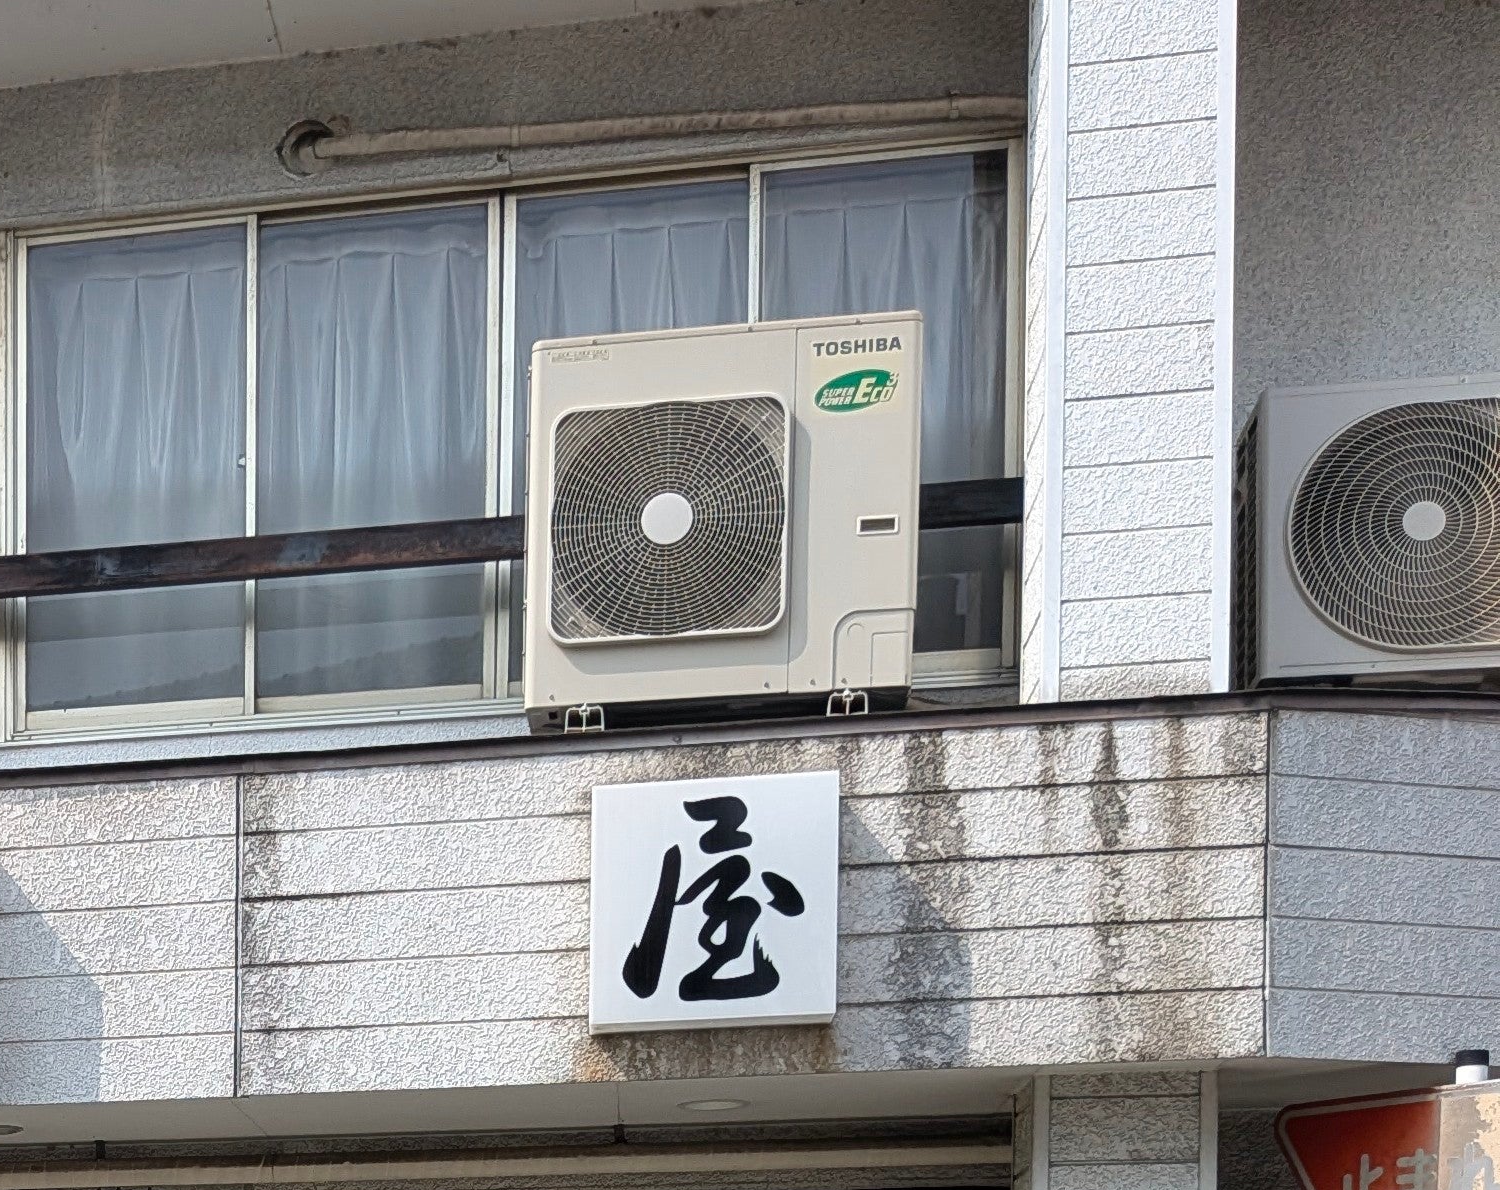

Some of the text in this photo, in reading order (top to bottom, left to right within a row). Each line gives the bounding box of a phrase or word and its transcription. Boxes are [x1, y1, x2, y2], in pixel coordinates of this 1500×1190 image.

[813, 337, 901, 356] TOSHIBA
[823, 387, 855, 397] SUPER
[819, 396, 852, 406] POWER
[622, 795, 805, 1001] 屋
